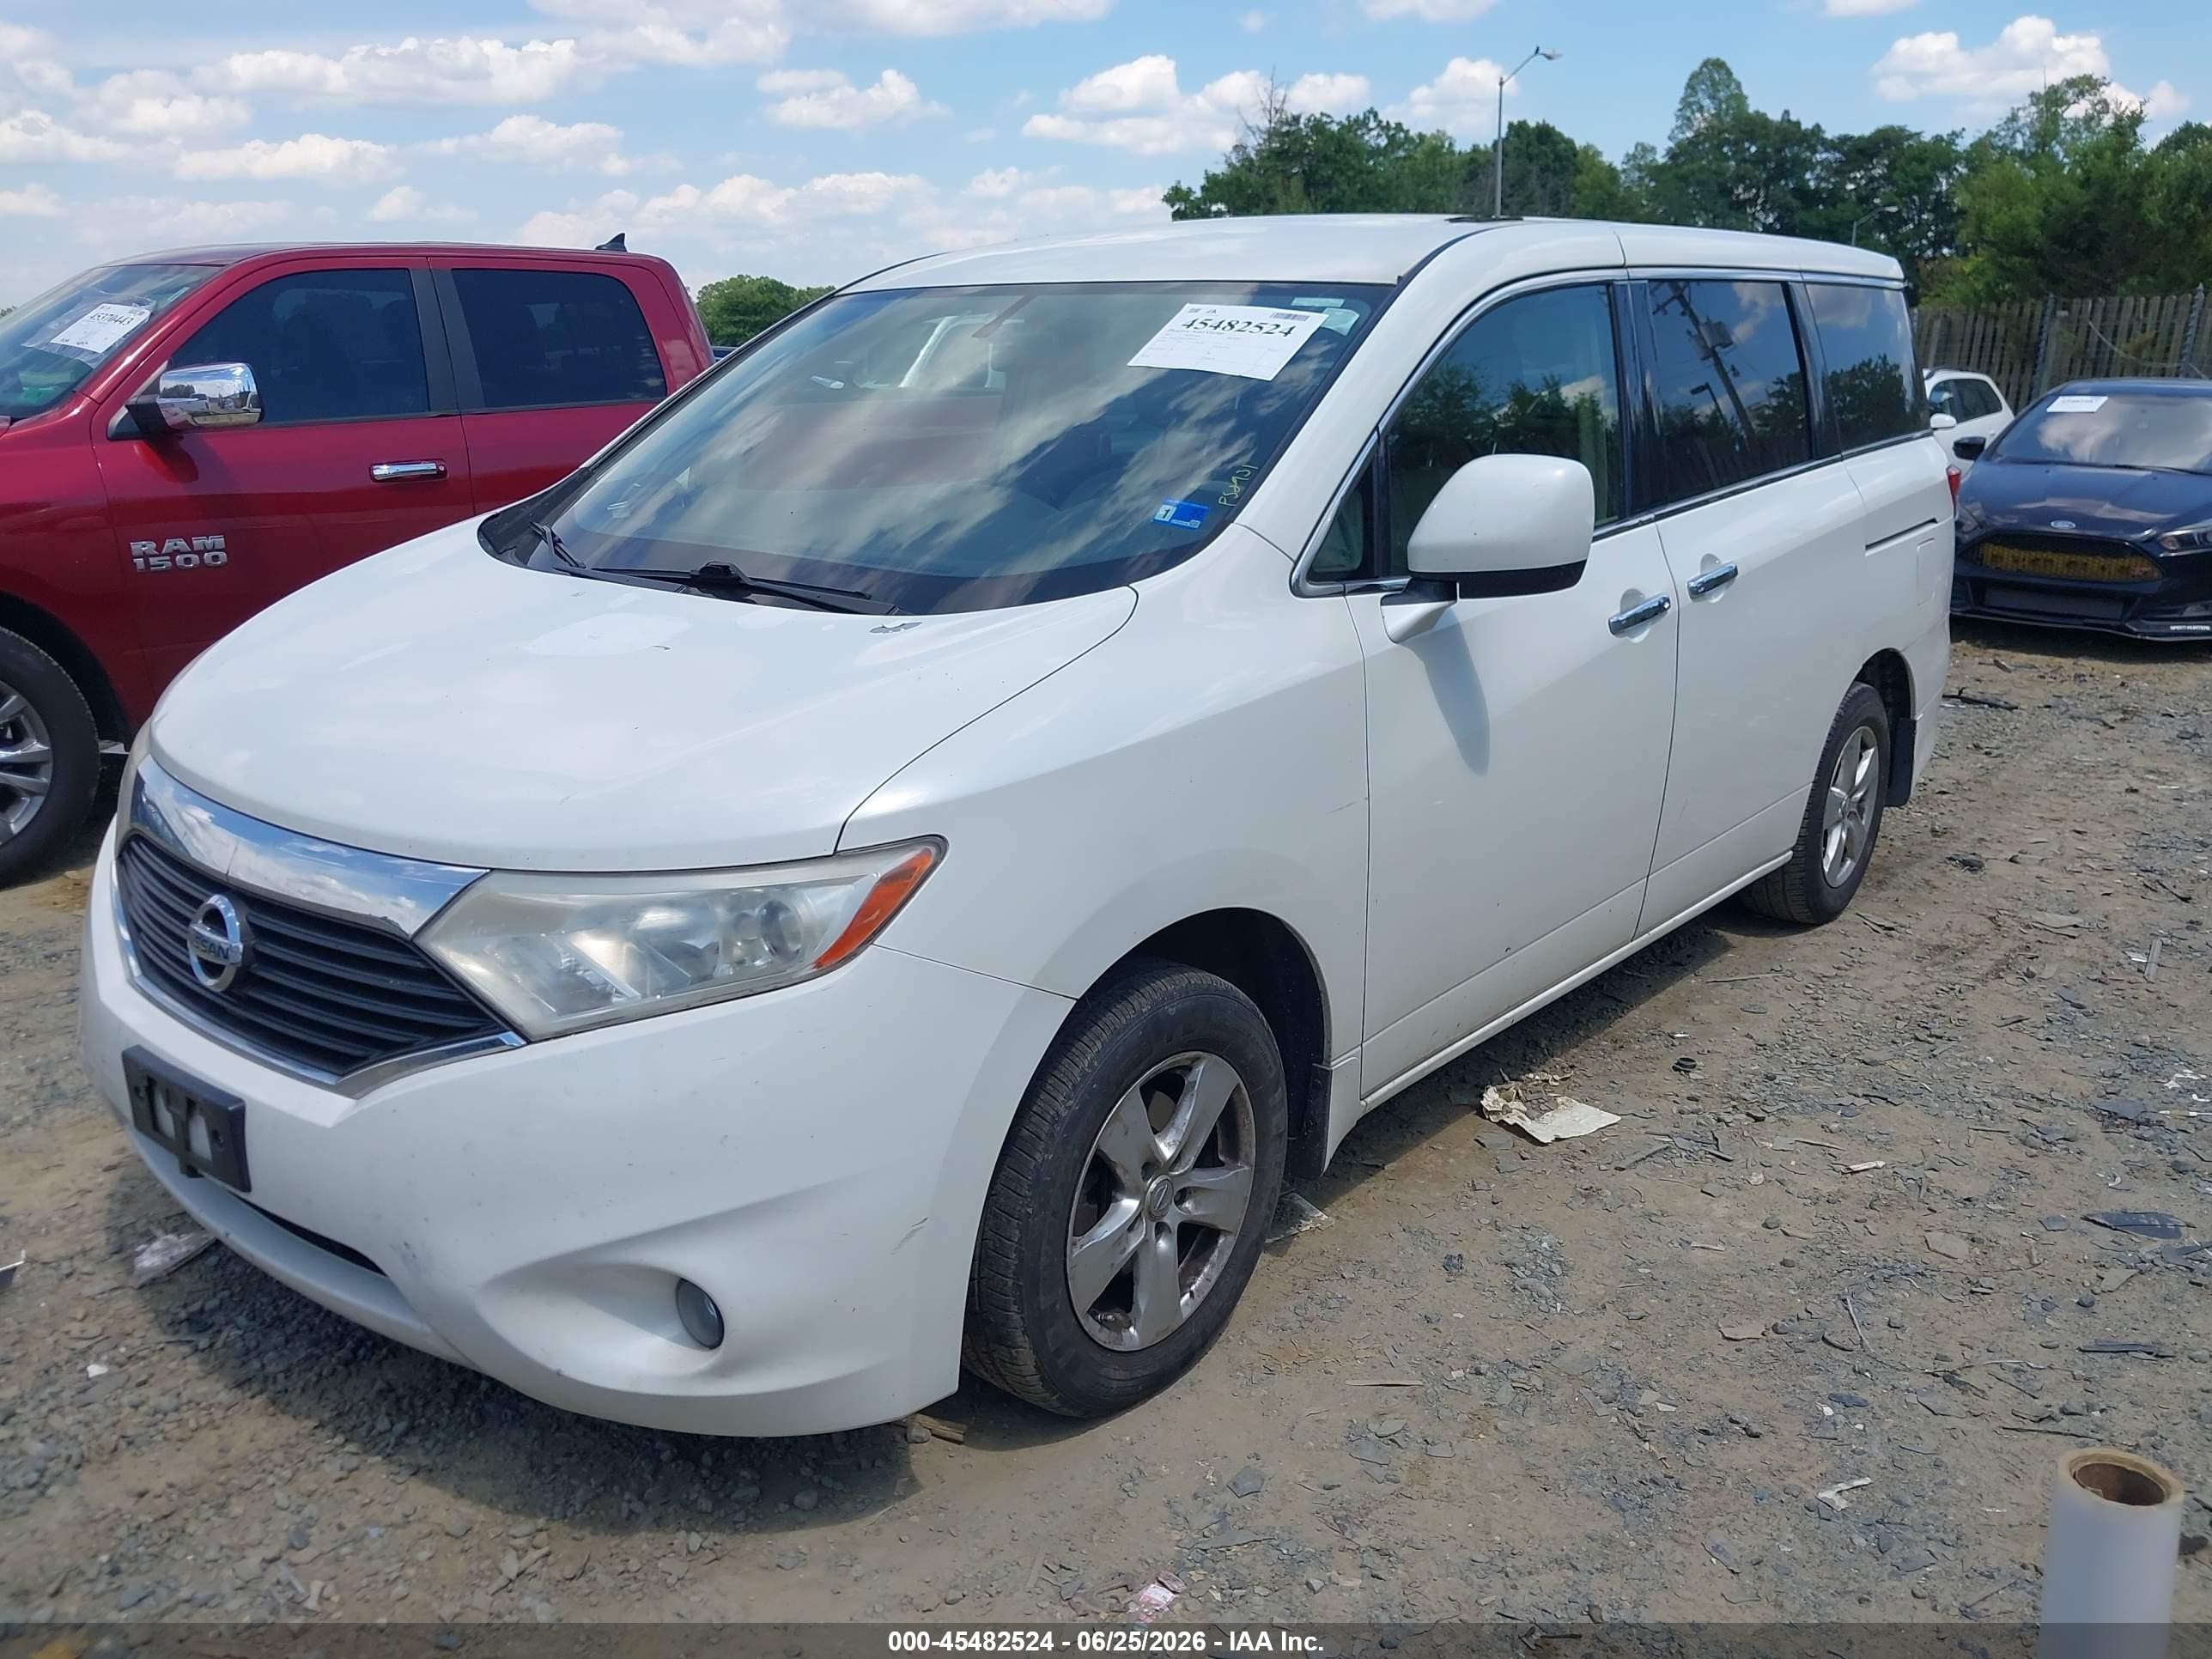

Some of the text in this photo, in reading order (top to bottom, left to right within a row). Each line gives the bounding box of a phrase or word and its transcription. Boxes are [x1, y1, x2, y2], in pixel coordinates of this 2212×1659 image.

[1182, 316, 1297, 337] 45482524
[130, 534, 227, 557] RAM
[132, 550, 228, 573] 1500
[191, 936, 230, 959] SSAN
